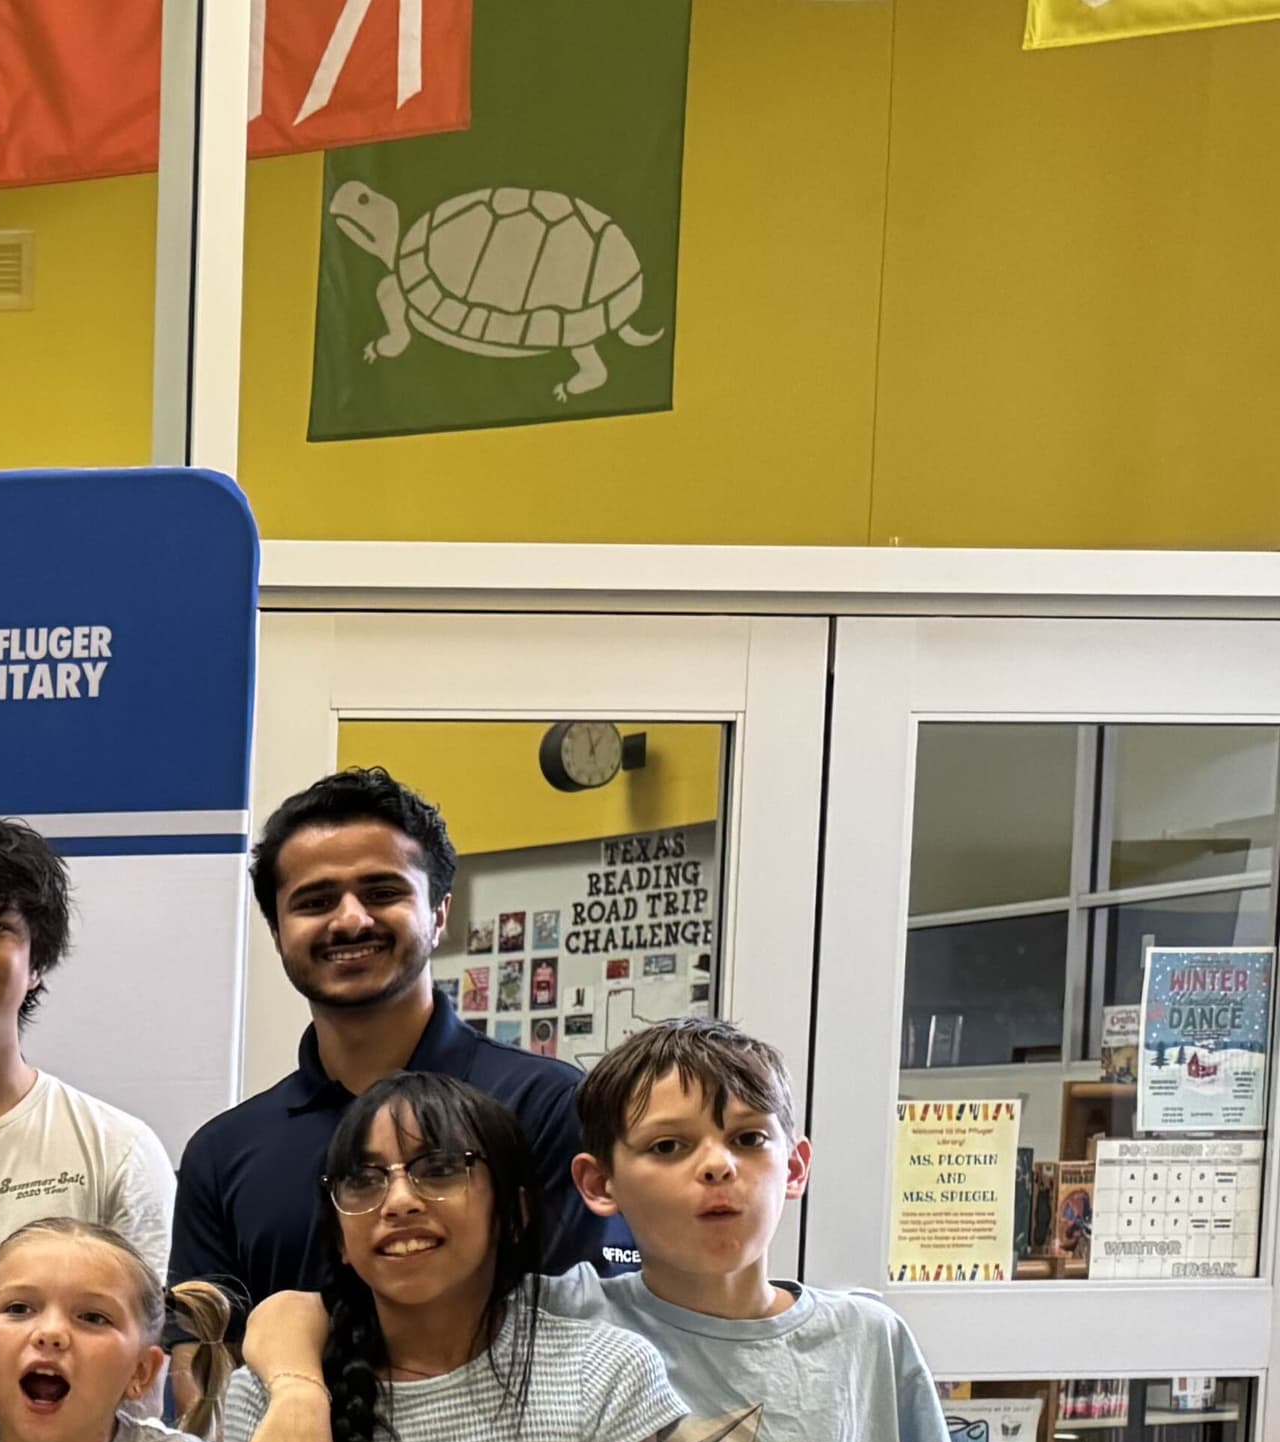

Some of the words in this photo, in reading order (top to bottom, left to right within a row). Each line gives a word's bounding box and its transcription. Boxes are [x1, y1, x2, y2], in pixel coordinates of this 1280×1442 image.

[604, 832, 686, 866] TEXAS
[587, 861, 701, 897] READING
[572, 897, 638, 925] ROAD
[646, 888, 708, 918] TRIP
[565, 920, 713, 954] CHALLENGE
[1169, 968, 1248, 993] WINTER
[1168, 1007, 1243, 1029] DANCE
[909, 1154, 934, 1167] MS.
[938, 1153, 998, 1166] PLOTKIN
[58, 1171, 85, 1186] Salt
[936, 1172, 967, 1184] AND
[902, 1191, 937, 1203] MRS.
[940, 1190, 998, 1203] SPIEGEL
[1104, 1240, 1182, 1256] WINTER
[1171, 1262, 1237, 1278] BREAK
